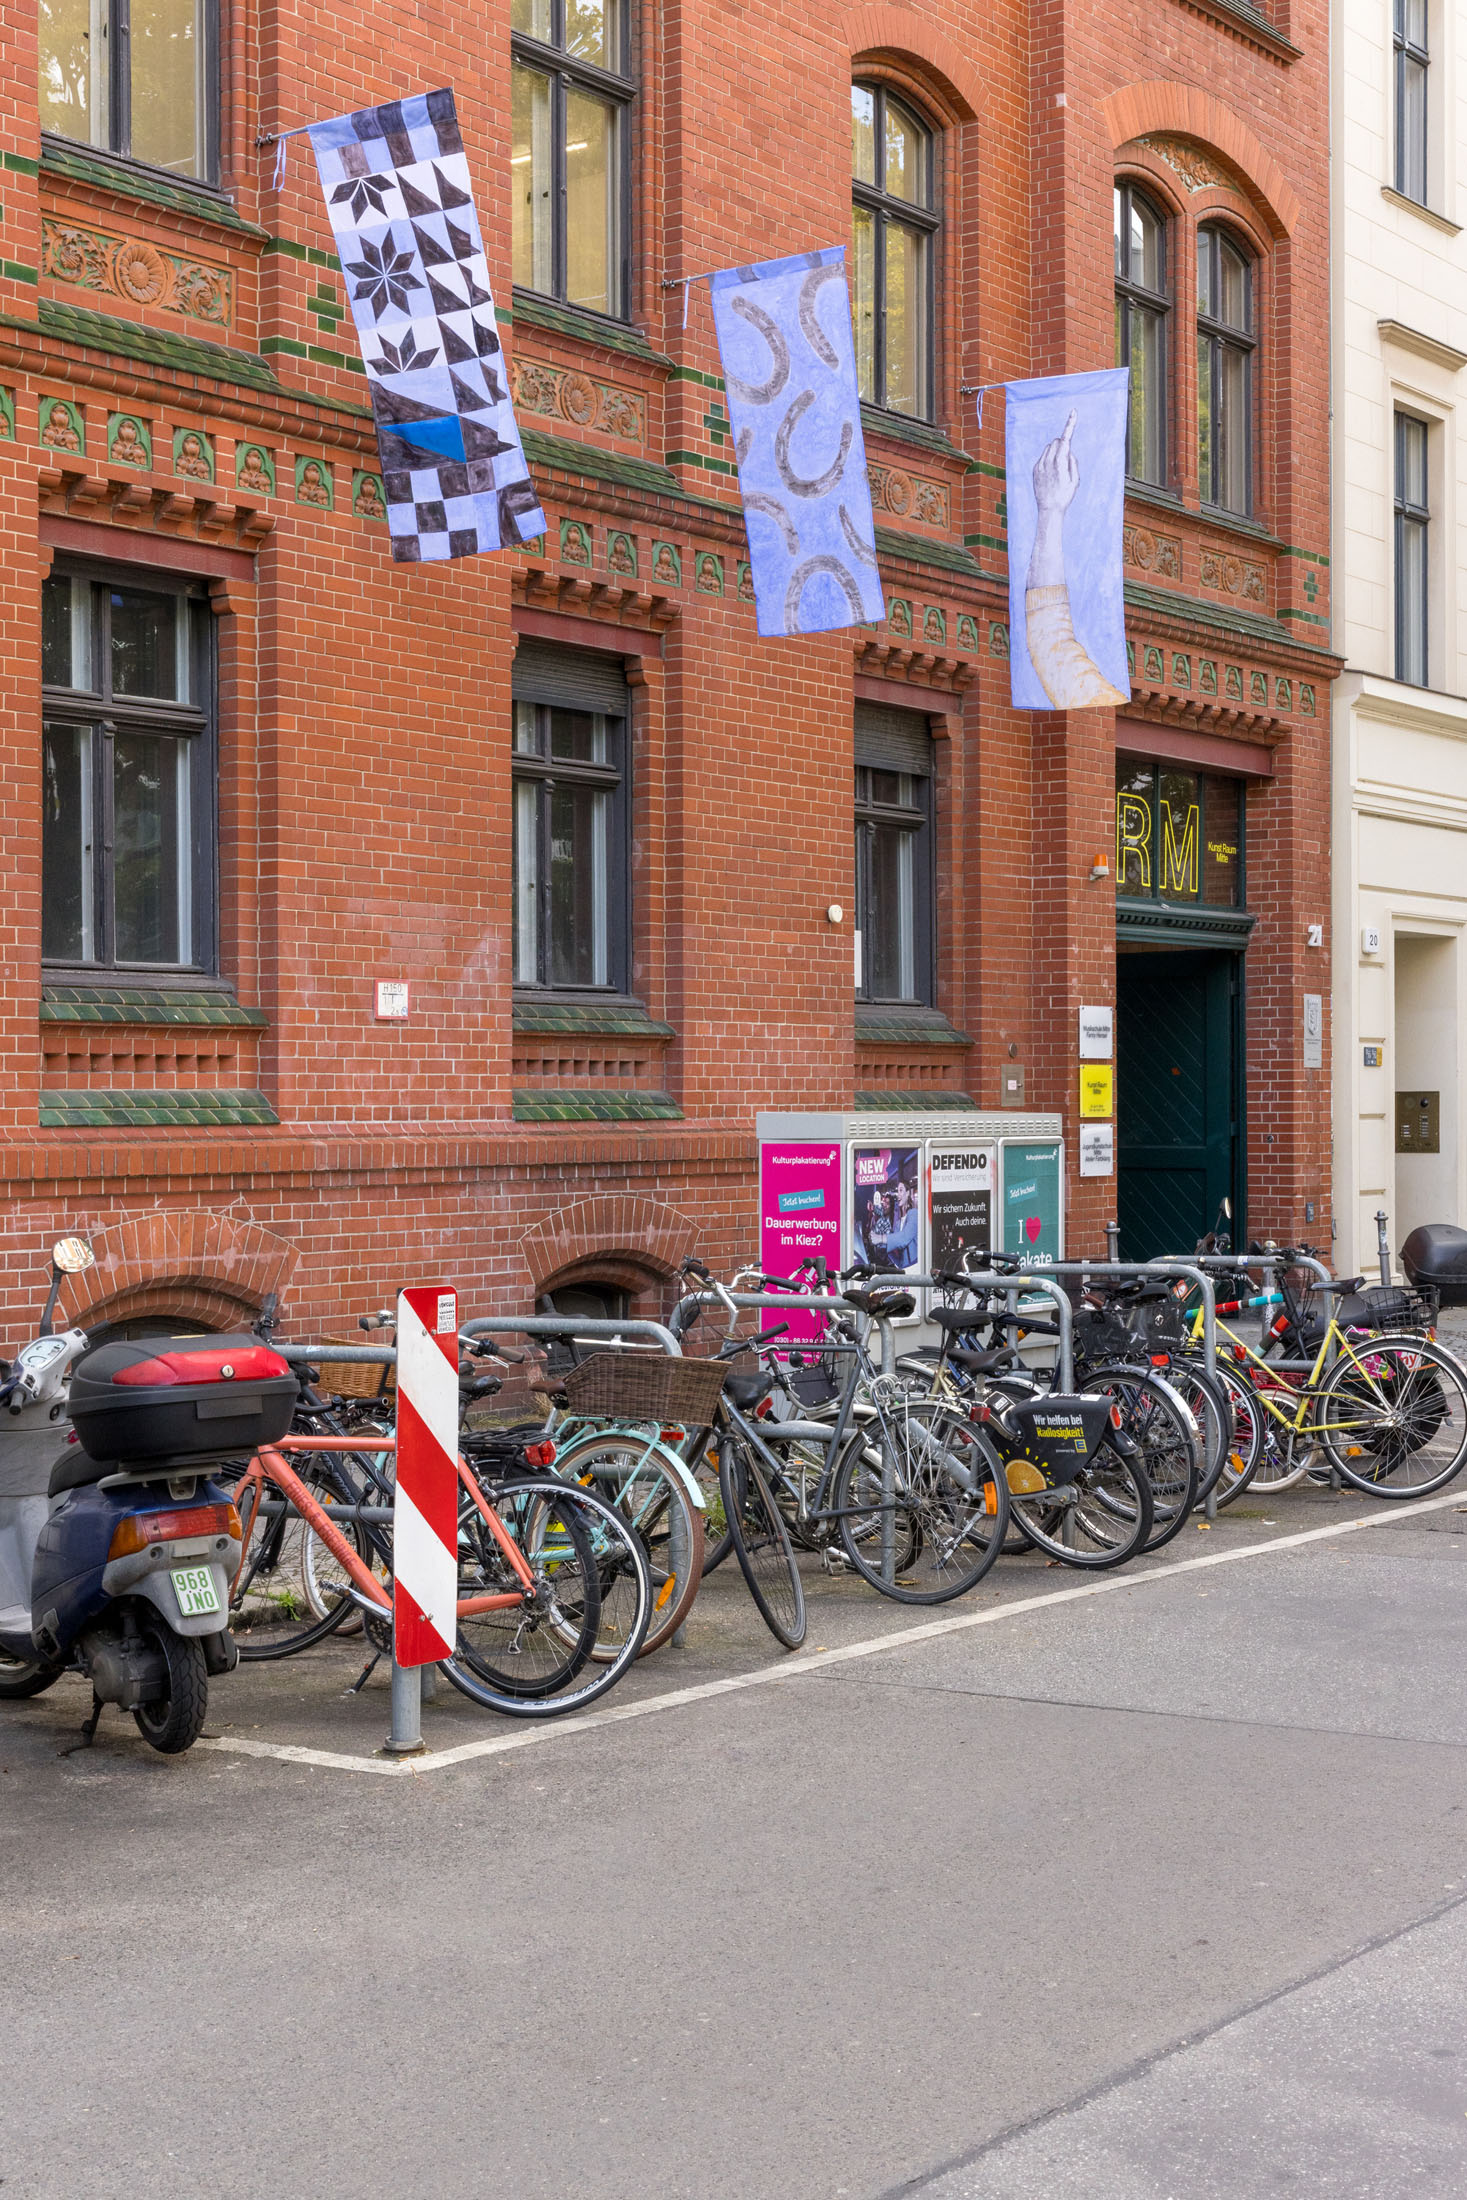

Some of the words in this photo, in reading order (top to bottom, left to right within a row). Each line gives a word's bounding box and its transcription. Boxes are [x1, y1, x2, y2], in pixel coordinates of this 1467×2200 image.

[1207, 841, 1223, 854] Kunst
[1223, 843, 1237, 855] Raum
[1215, 852, 1229, 864] Mitte
[1307, 924, 1323, 947] 21
[1369, 934, 1379, 946] 20
[772, 1156, 831, 1167] Kulturplakatierung
[932, 1153, 987, 1171] DEFENDO
[1025, 1153, 1055, 1161] Kulturplakatierung
[859, 1159, 885, 1175] NEW
[859, 1174, 885, 1184] LOCATION
[942, 1174, 952, 1182] sind
[952, 1173, 987, 1182] Versicherung
[1009, 1187, 1020, 1199] Jetzt
[1020, 1183, 1036, 1196] buchen!
[782, 1197, 798, 1207] Jetzt
[798, 1193, 821, 1205] buchen!
[932, 1204, 942, 1214] Wir
[942, 1203, 963, 1214] sichern
[964, 1201, 987, 1212] Zukunft.
[765, 1216, 837, 1233] Dauerwerbung
[955, 1217, 969, 1227] Auch
[970, 1216, 987, 1226] deine.
[1018, 1219, 1024, 1244] I
[780, 1233, 793, 1245] im
[795, 1234, 823, 1246] Kiez?
[1033, 1414, 1046, 1425] Wir
[1047, 1414, 1070, 1425] helfen
[1070, 1414, 1083, 1425] bei
[1036, 1426, 1085, 1440] Radlosigkeit!
[175, 1570, 209, 1592] 968
[186, 1590, 215, 1612] JNO
